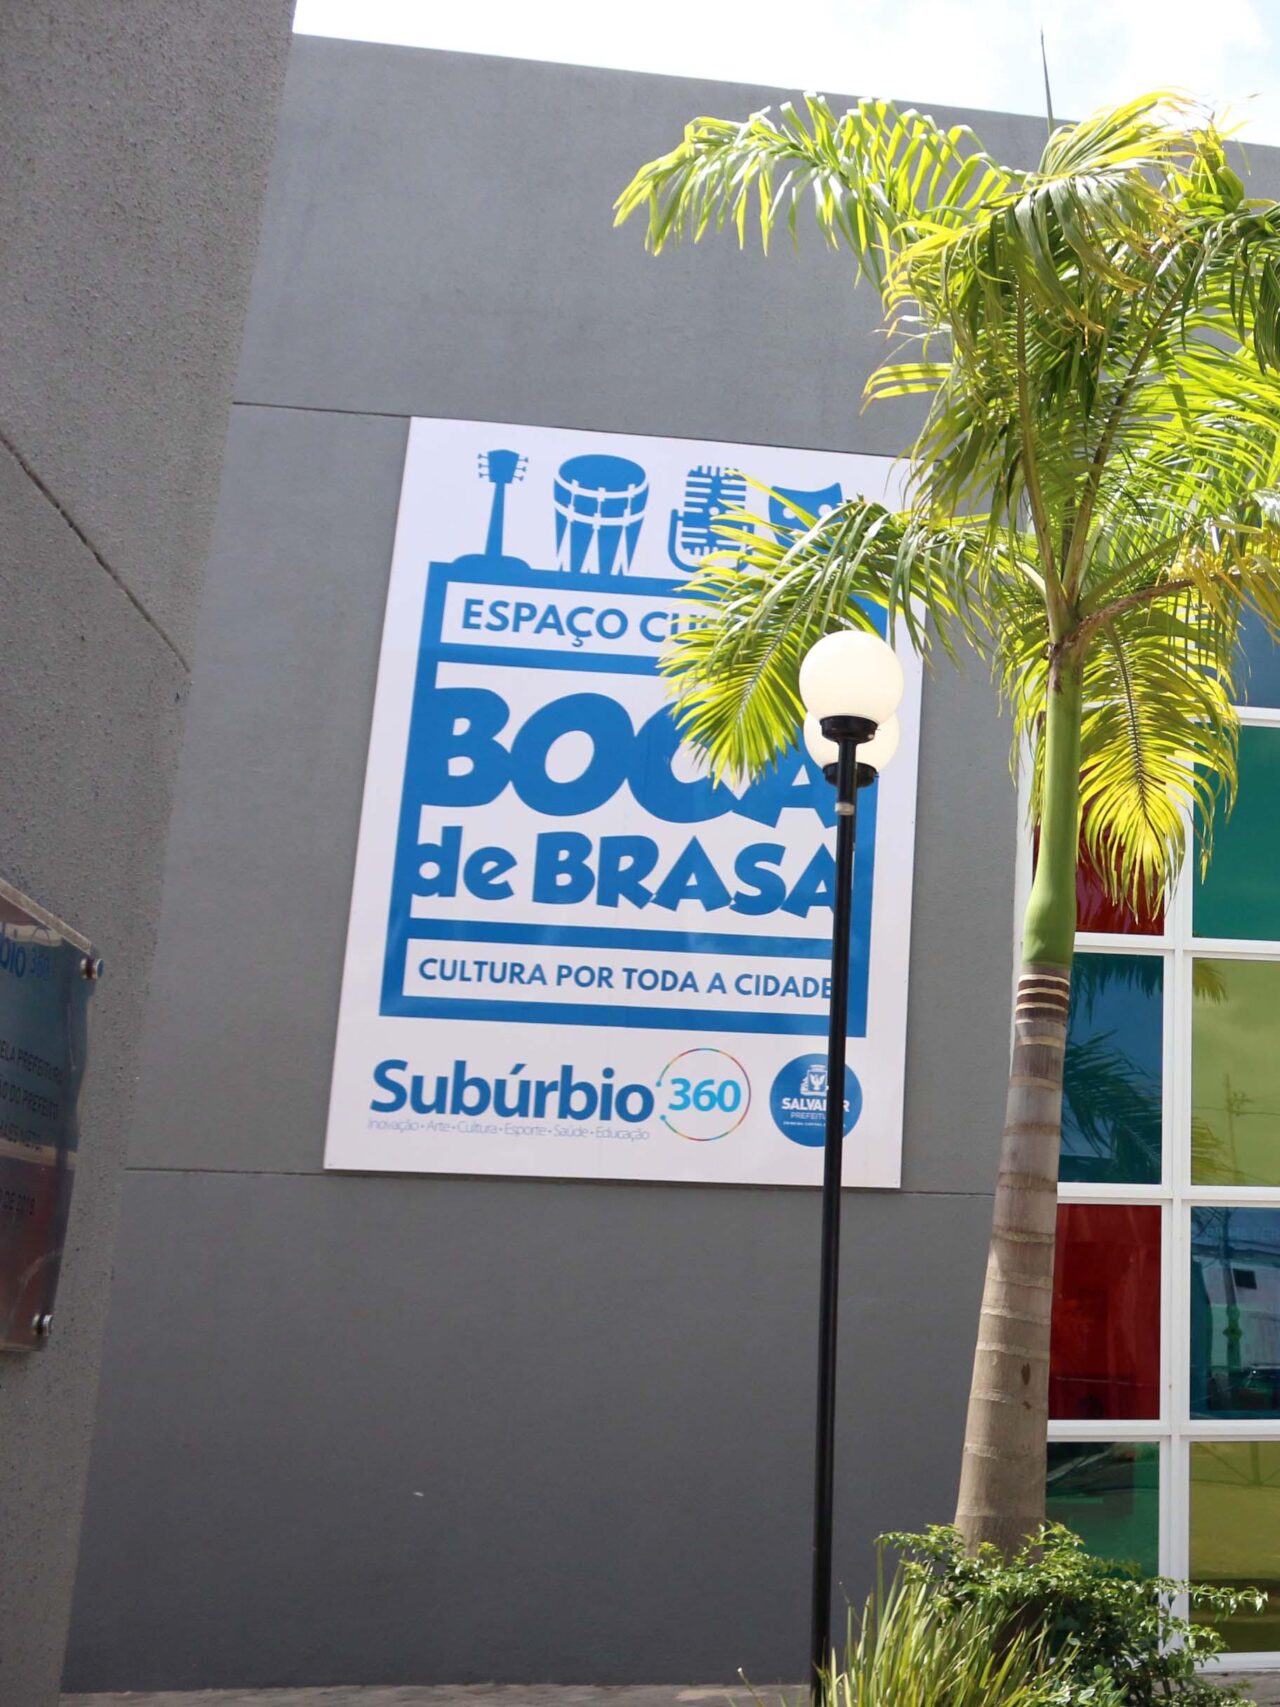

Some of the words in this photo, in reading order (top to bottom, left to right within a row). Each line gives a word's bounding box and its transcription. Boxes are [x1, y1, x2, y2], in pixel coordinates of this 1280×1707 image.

[462, 598, 628, 647] ESPAÇO
[428, 688, 839, 829] BOCA
[414, 826, 518, 901] de
[532, 831, 837, 919] BRASA
[418, 957, 548, 986] CULTURA
[555, 964, 615, 989] POR
[622, 967, 700, 993] TODA
[706, 971, 728, 994] A
[734, 974, 832, 999] CIDADE
[370, 1058, 655, 1123] Subúrbio
[668, 1077, 742, 1113] 360
[782, 1097, 850, 1113] SALVAR
